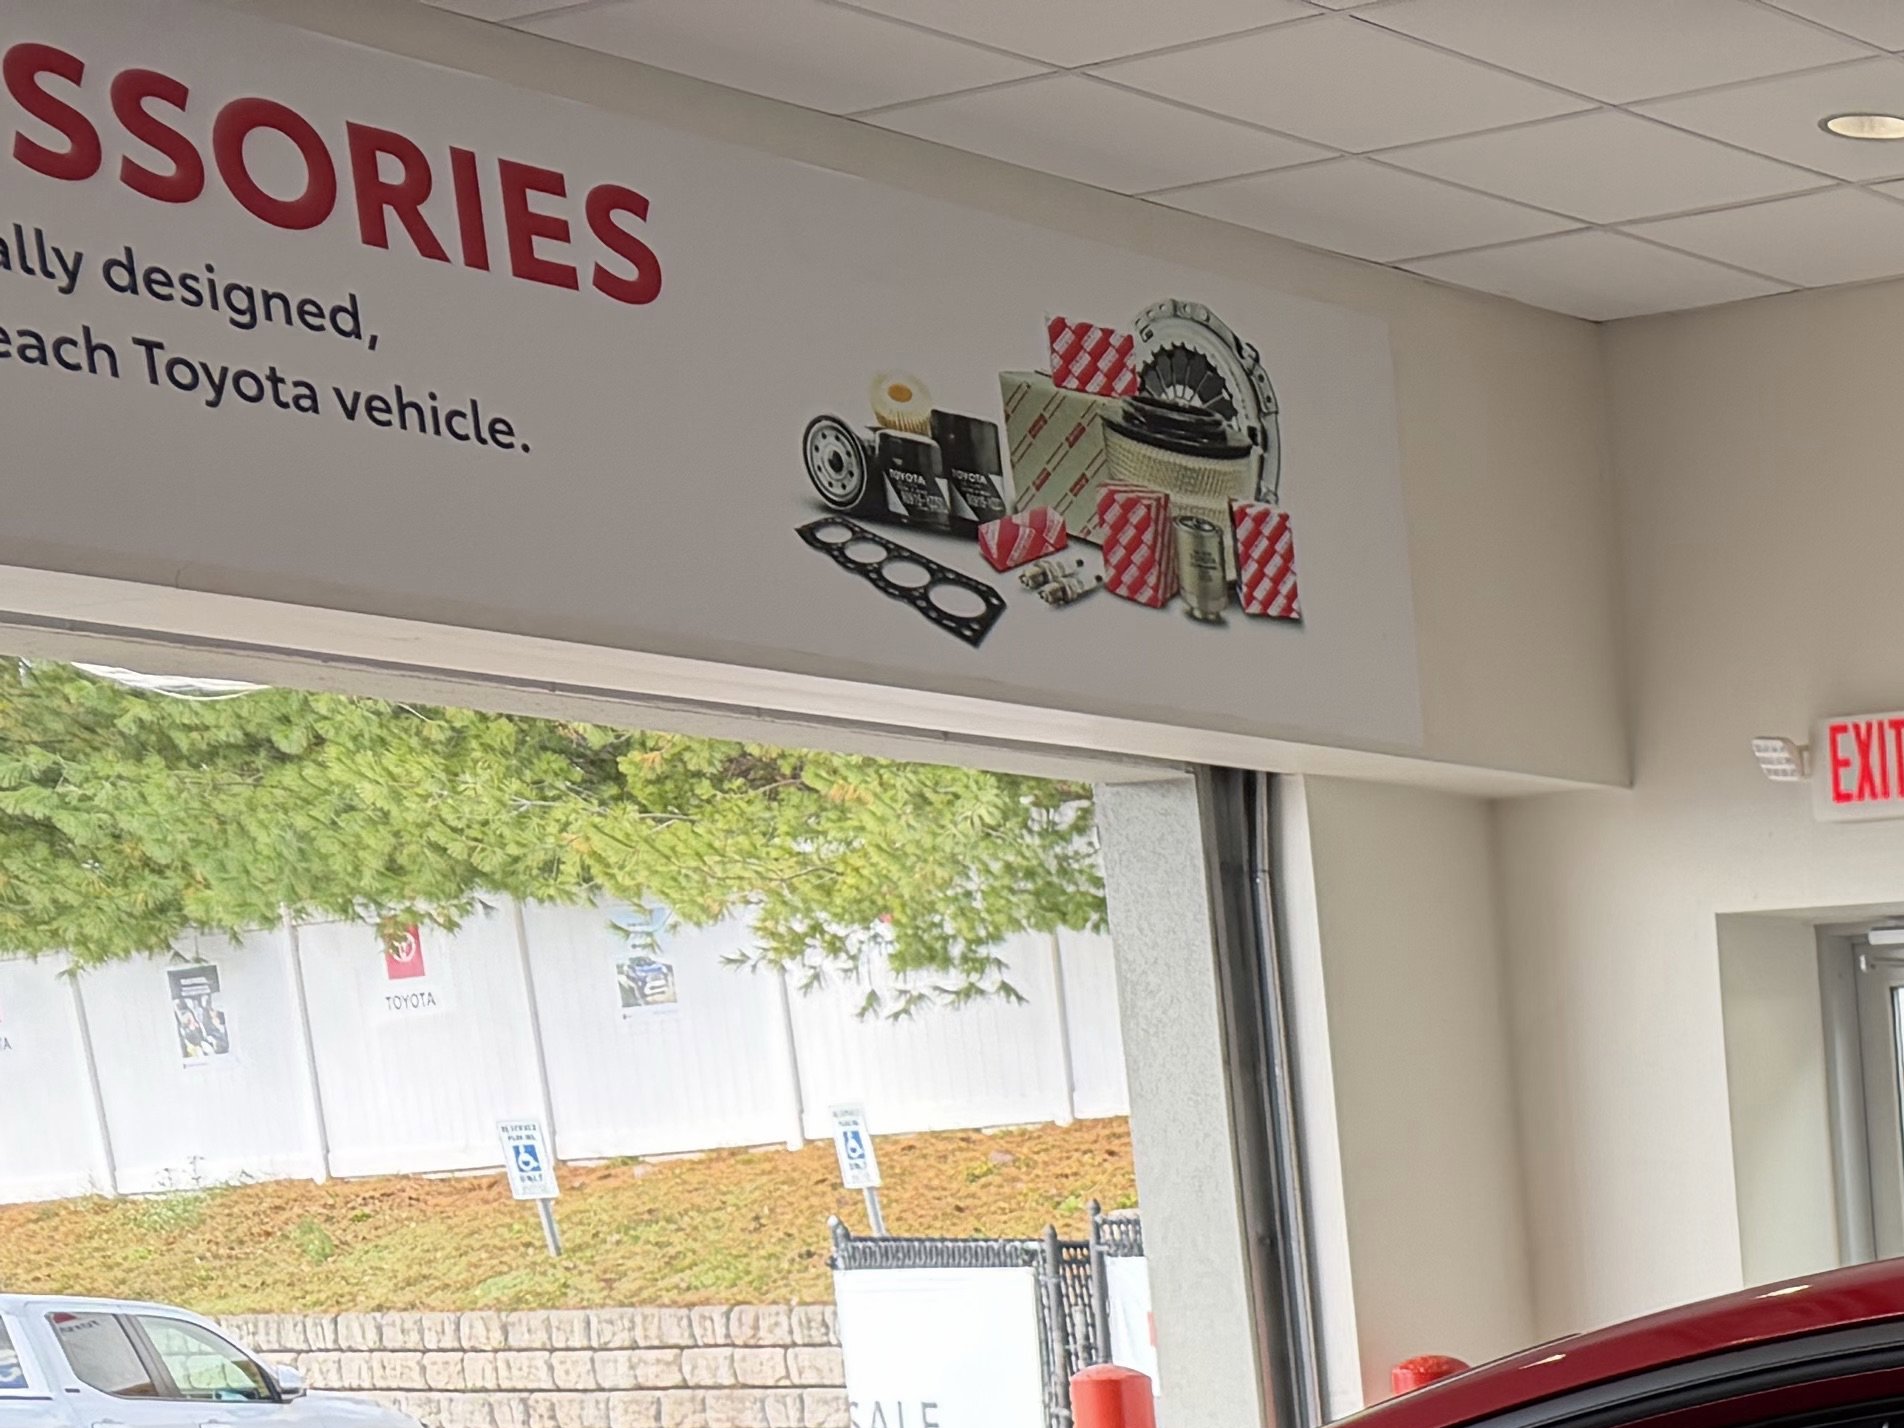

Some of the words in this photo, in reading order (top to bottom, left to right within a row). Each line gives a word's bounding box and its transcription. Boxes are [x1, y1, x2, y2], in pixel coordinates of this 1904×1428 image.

[2, 42, 662, 305] SSORIES
[102, 246, 379, 350] designed,
[132, 336, 319, 408] Toyota
[332, 383, 531, 453] vehicle.
[385, 991, 437, 1012] TOYOTA
